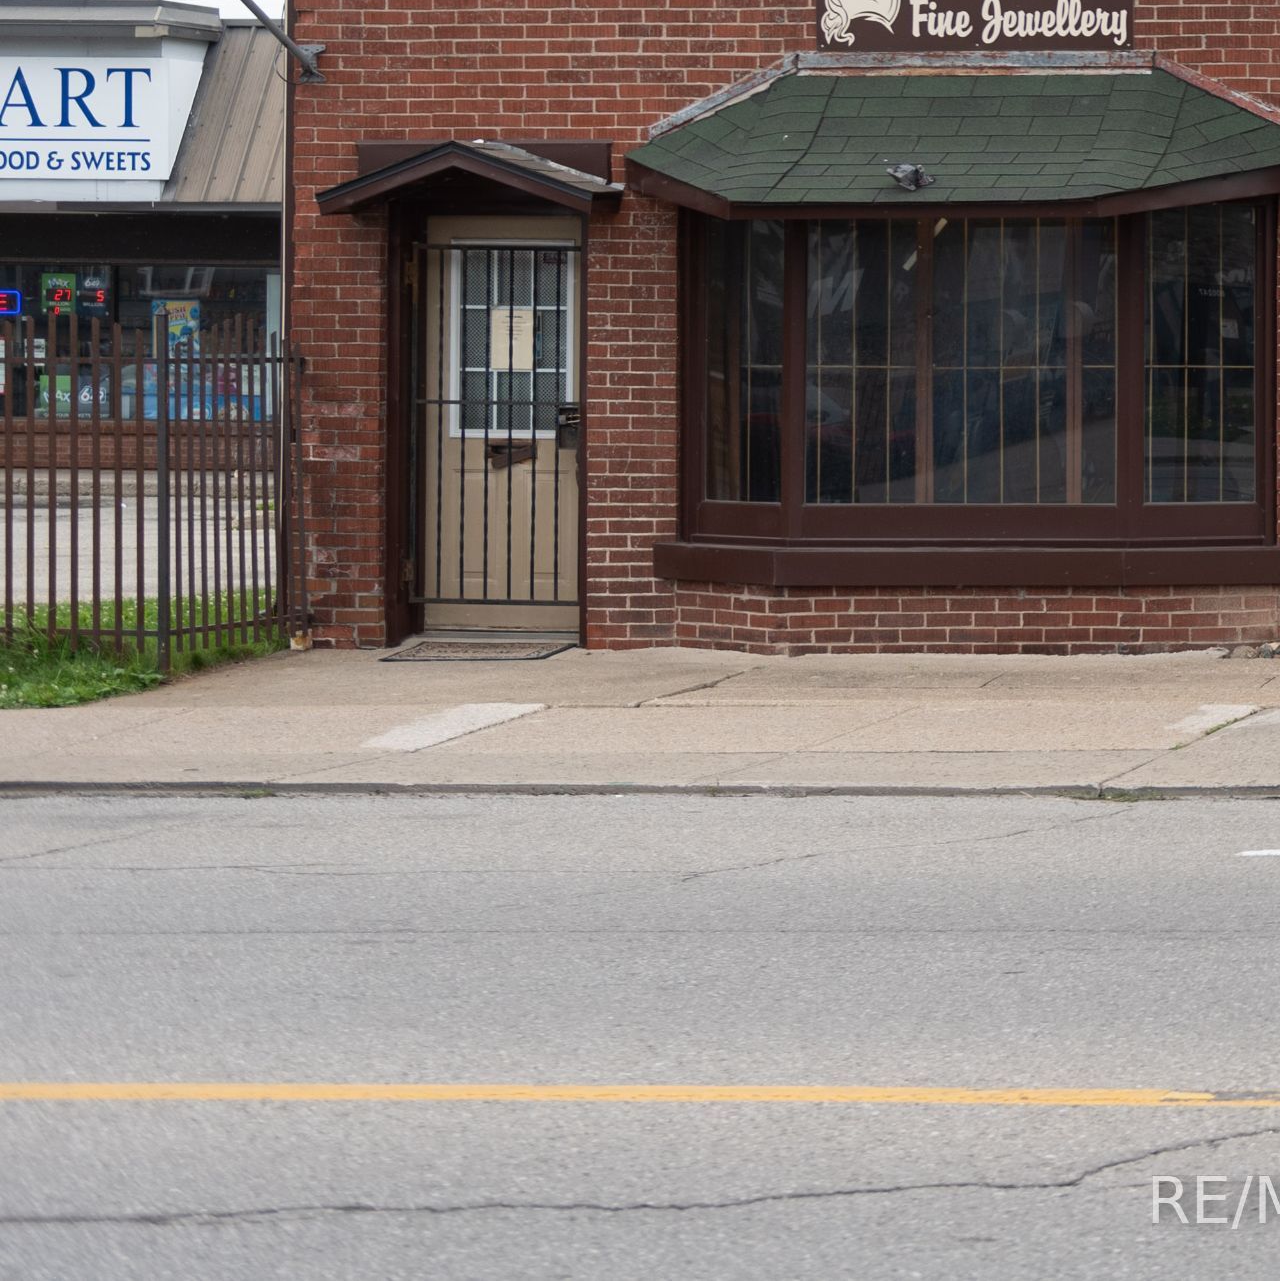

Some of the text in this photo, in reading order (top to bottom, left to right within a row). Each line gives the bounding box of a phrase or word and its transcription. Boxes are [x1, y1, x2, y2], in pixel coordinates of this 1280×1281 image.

[47, 151, 64, 170] &
[71, 151, 151, 171] SWEETS
[84, 278, 100, 287] 649
[54, 289, 71, 301] 27
[96, 290, 105, 302] 5
[80, 386, 106, 402] 69
